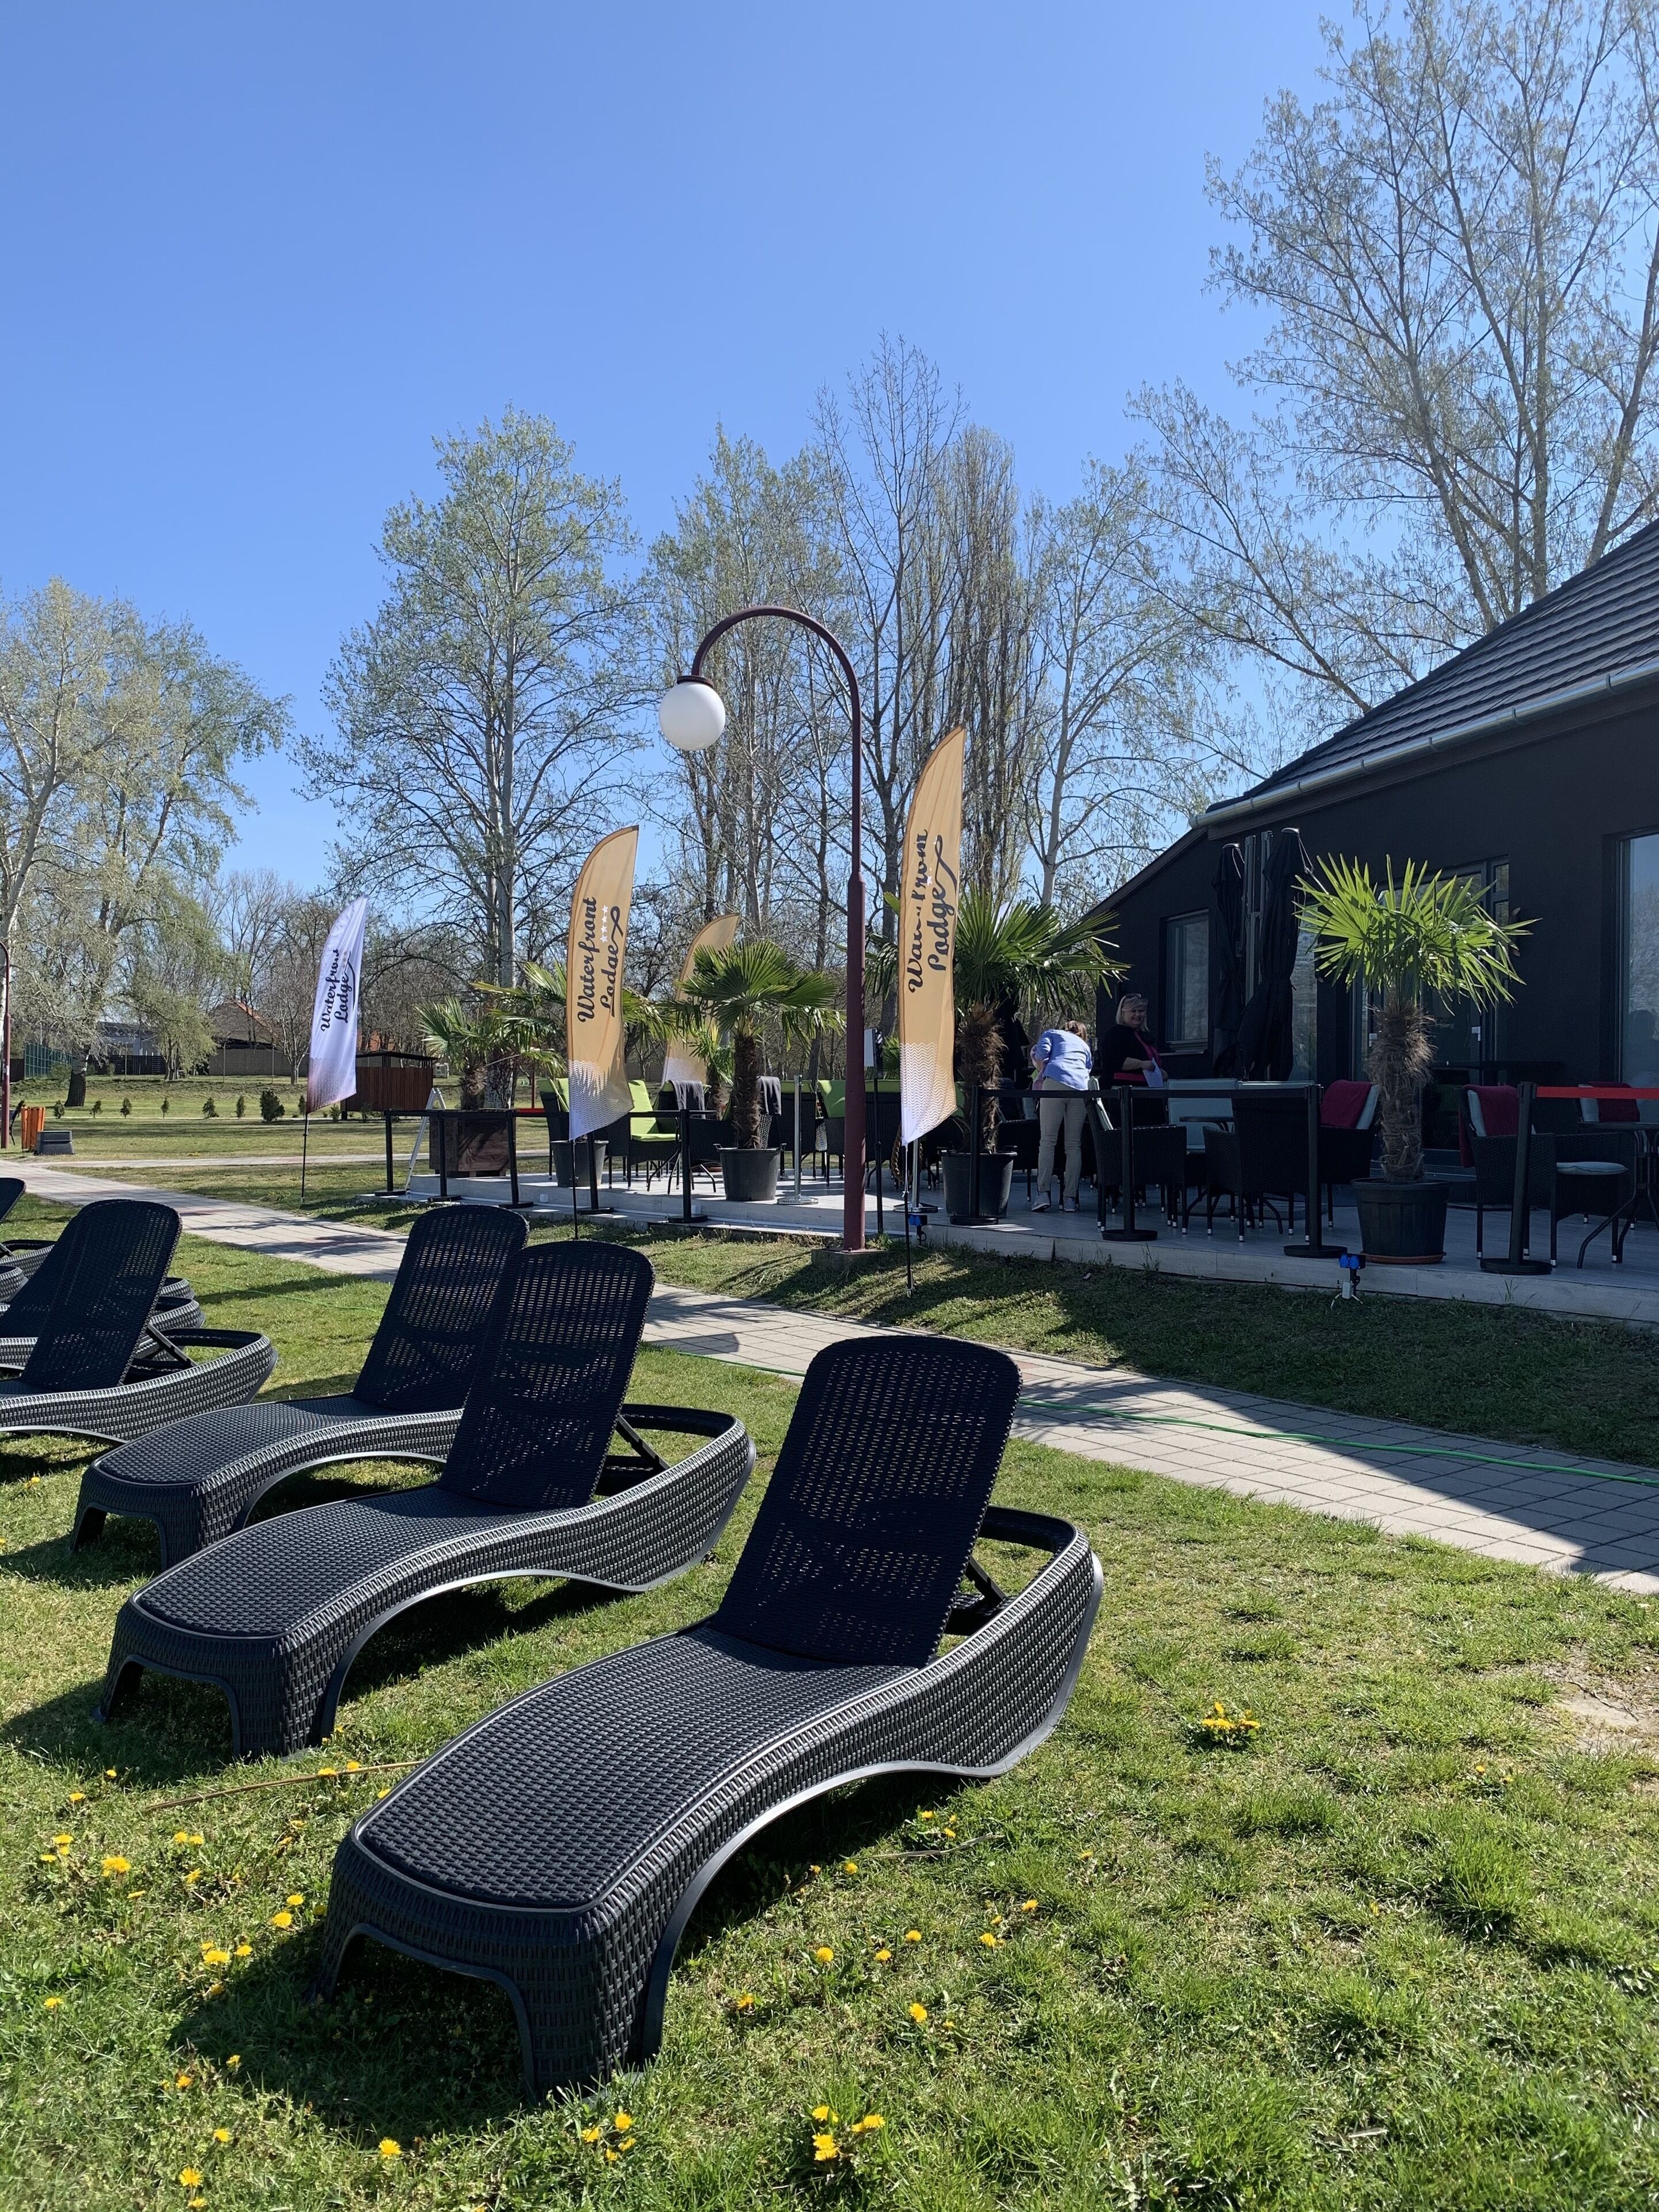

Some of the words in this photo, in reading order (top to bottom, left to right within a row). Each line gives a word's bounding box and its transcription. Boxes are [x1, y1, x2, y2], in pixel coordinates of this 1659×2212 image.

[577, 896, 600, 1022] Waterfront
[907, 830, 928, 993] Watfront
[334, 950, 355, 1024] Lodge
